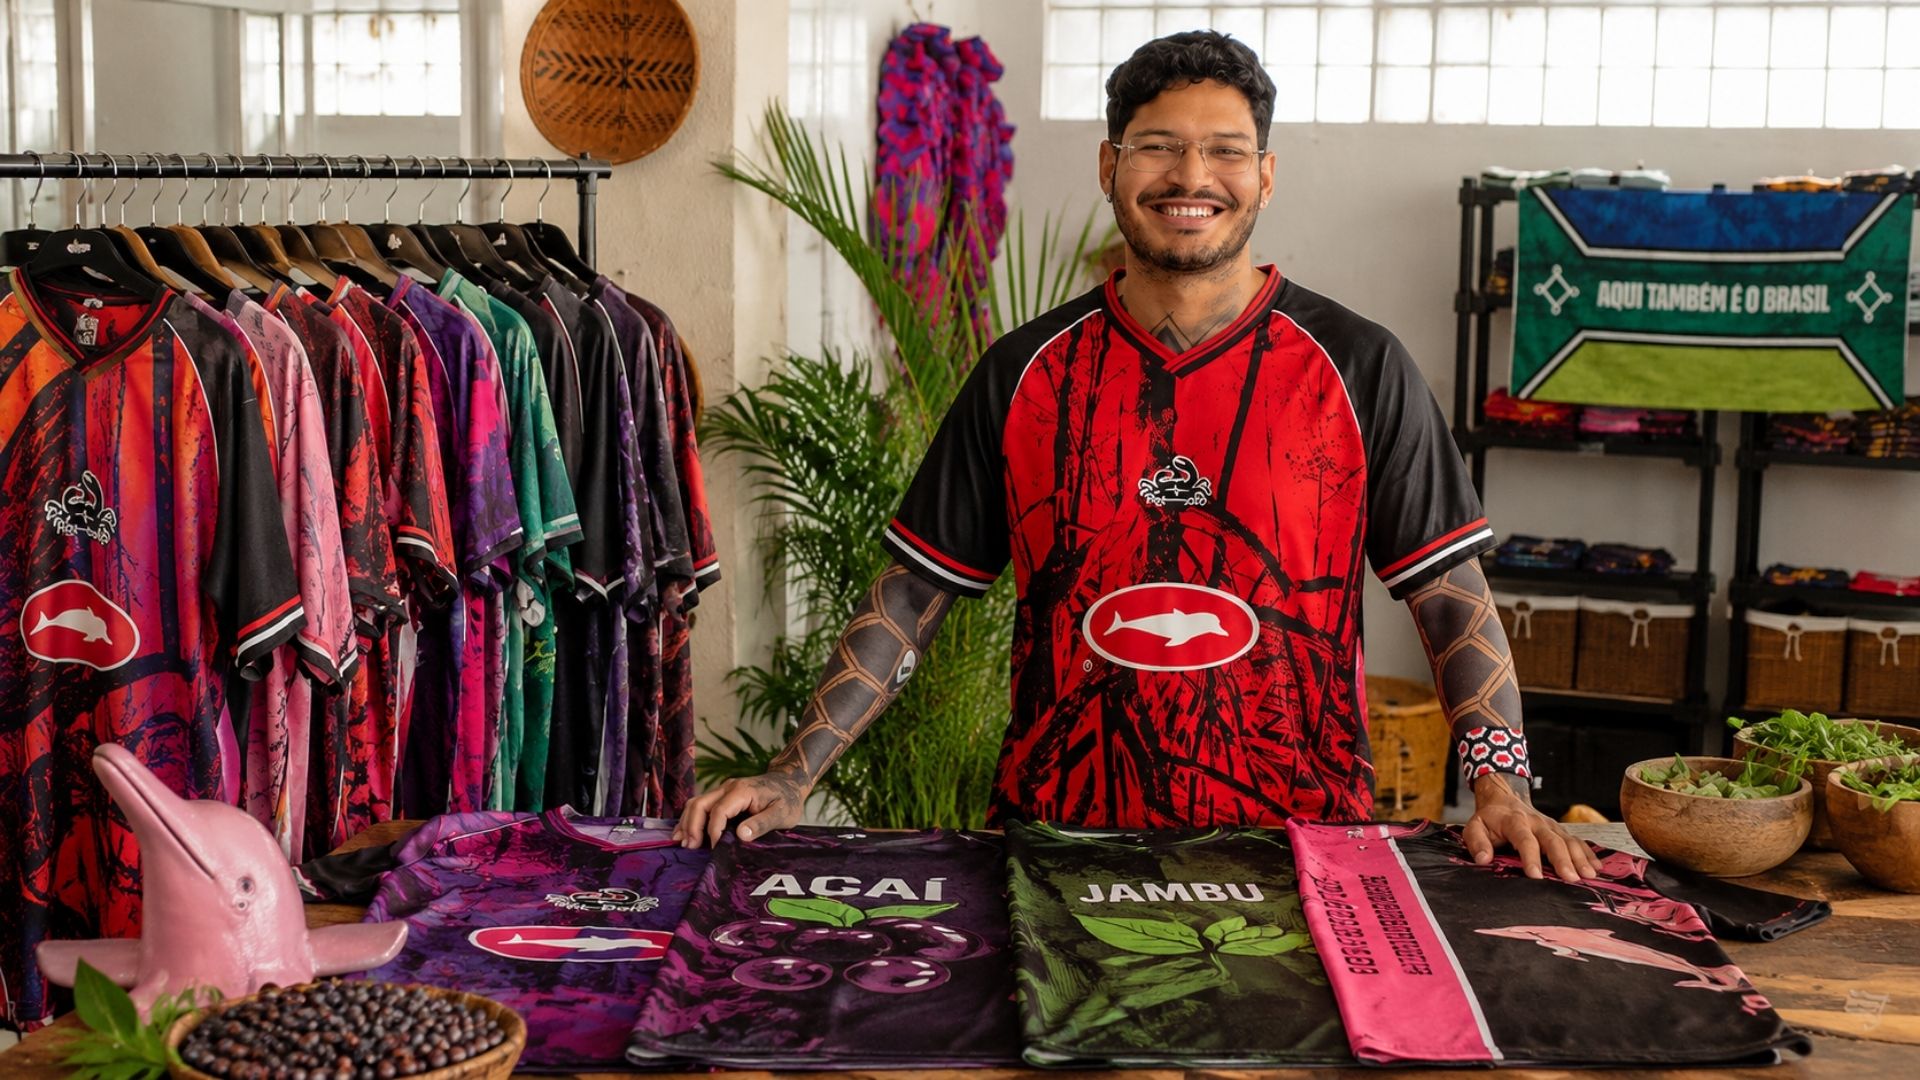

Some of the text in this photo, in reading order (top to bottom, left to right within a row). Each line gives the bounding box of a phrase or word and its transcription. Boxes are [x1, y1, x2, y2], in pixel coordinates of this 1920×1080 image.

[1597, 280, 1831, 314] AQUI TAMBÉM É O BRASIL
[1079, 882, 1265, 903] JAMBU
